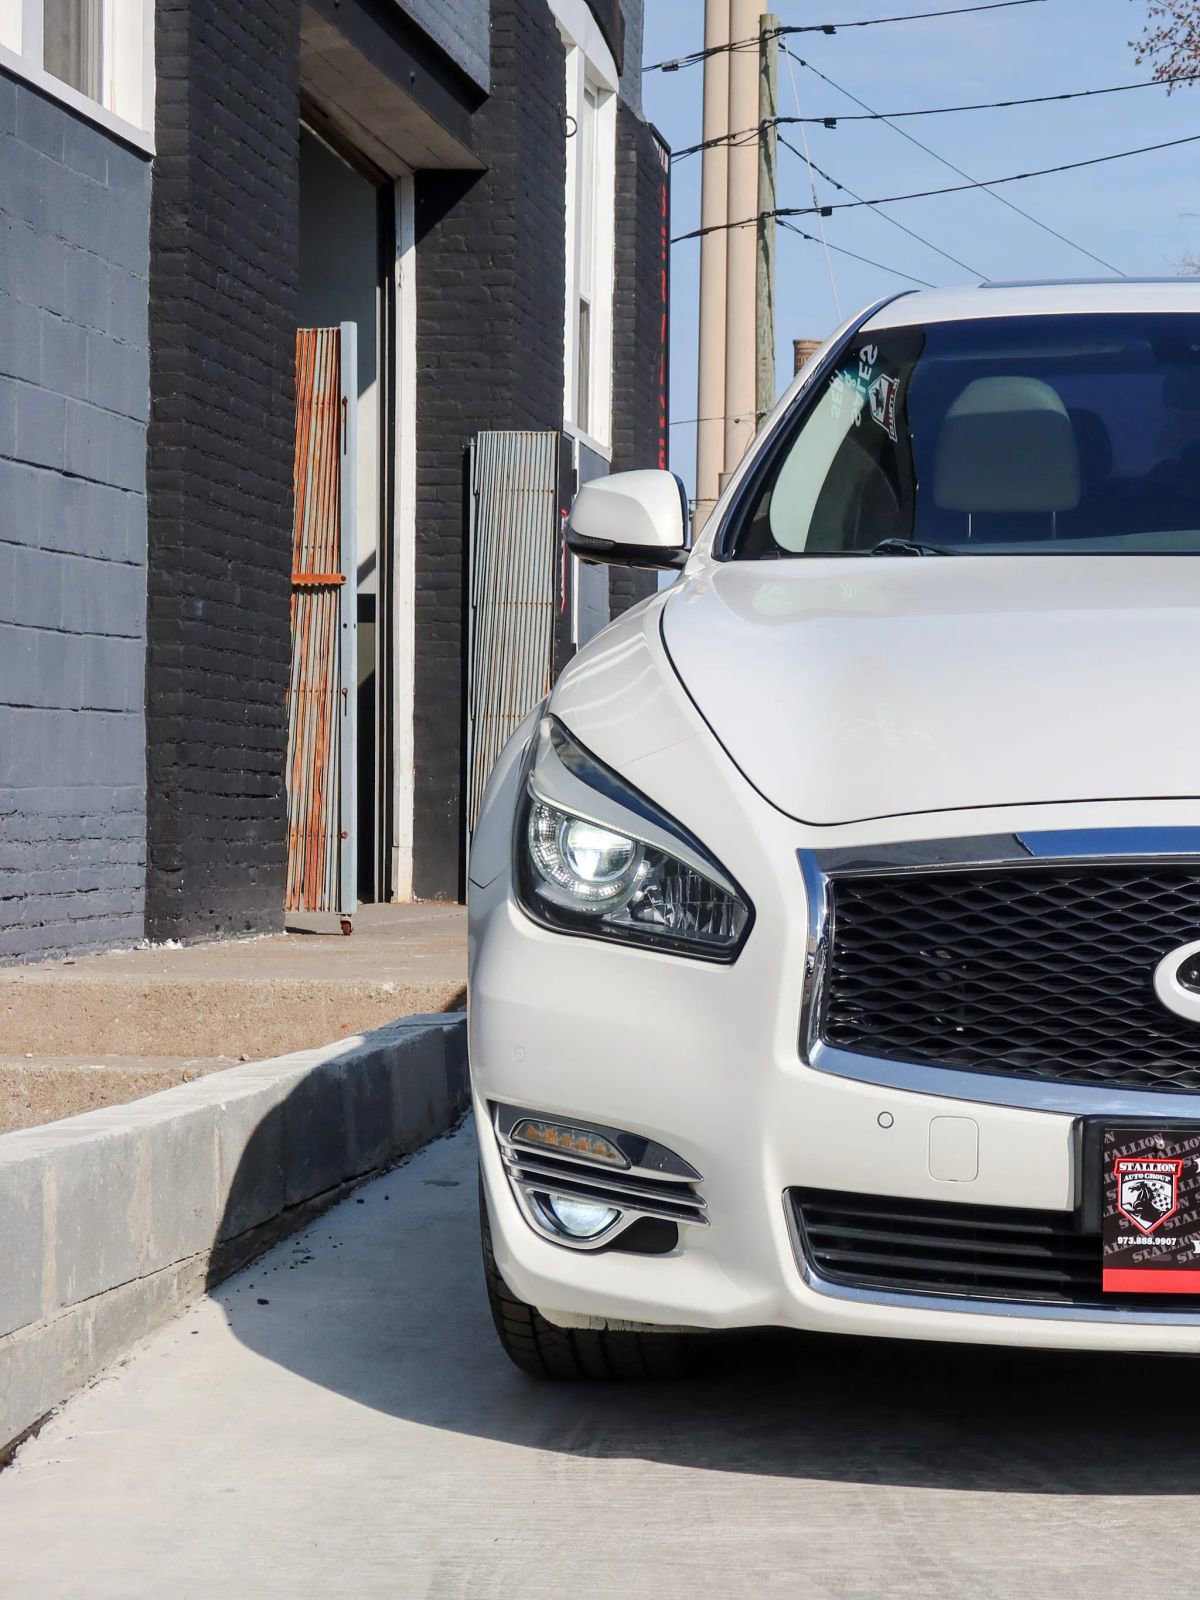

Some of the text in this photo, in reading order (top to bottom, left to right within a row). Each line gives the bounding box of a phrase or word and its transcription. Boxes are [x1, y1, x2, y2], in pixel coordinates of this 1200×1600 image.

[1119, 1162, 1177, 1172] STALLION
[1124, 1174, 1144, 1182] AUTO
[1144, 1174, 1171, 1182] GROUP
[1117, 1237, 1177, 1246] 973.888.9907
